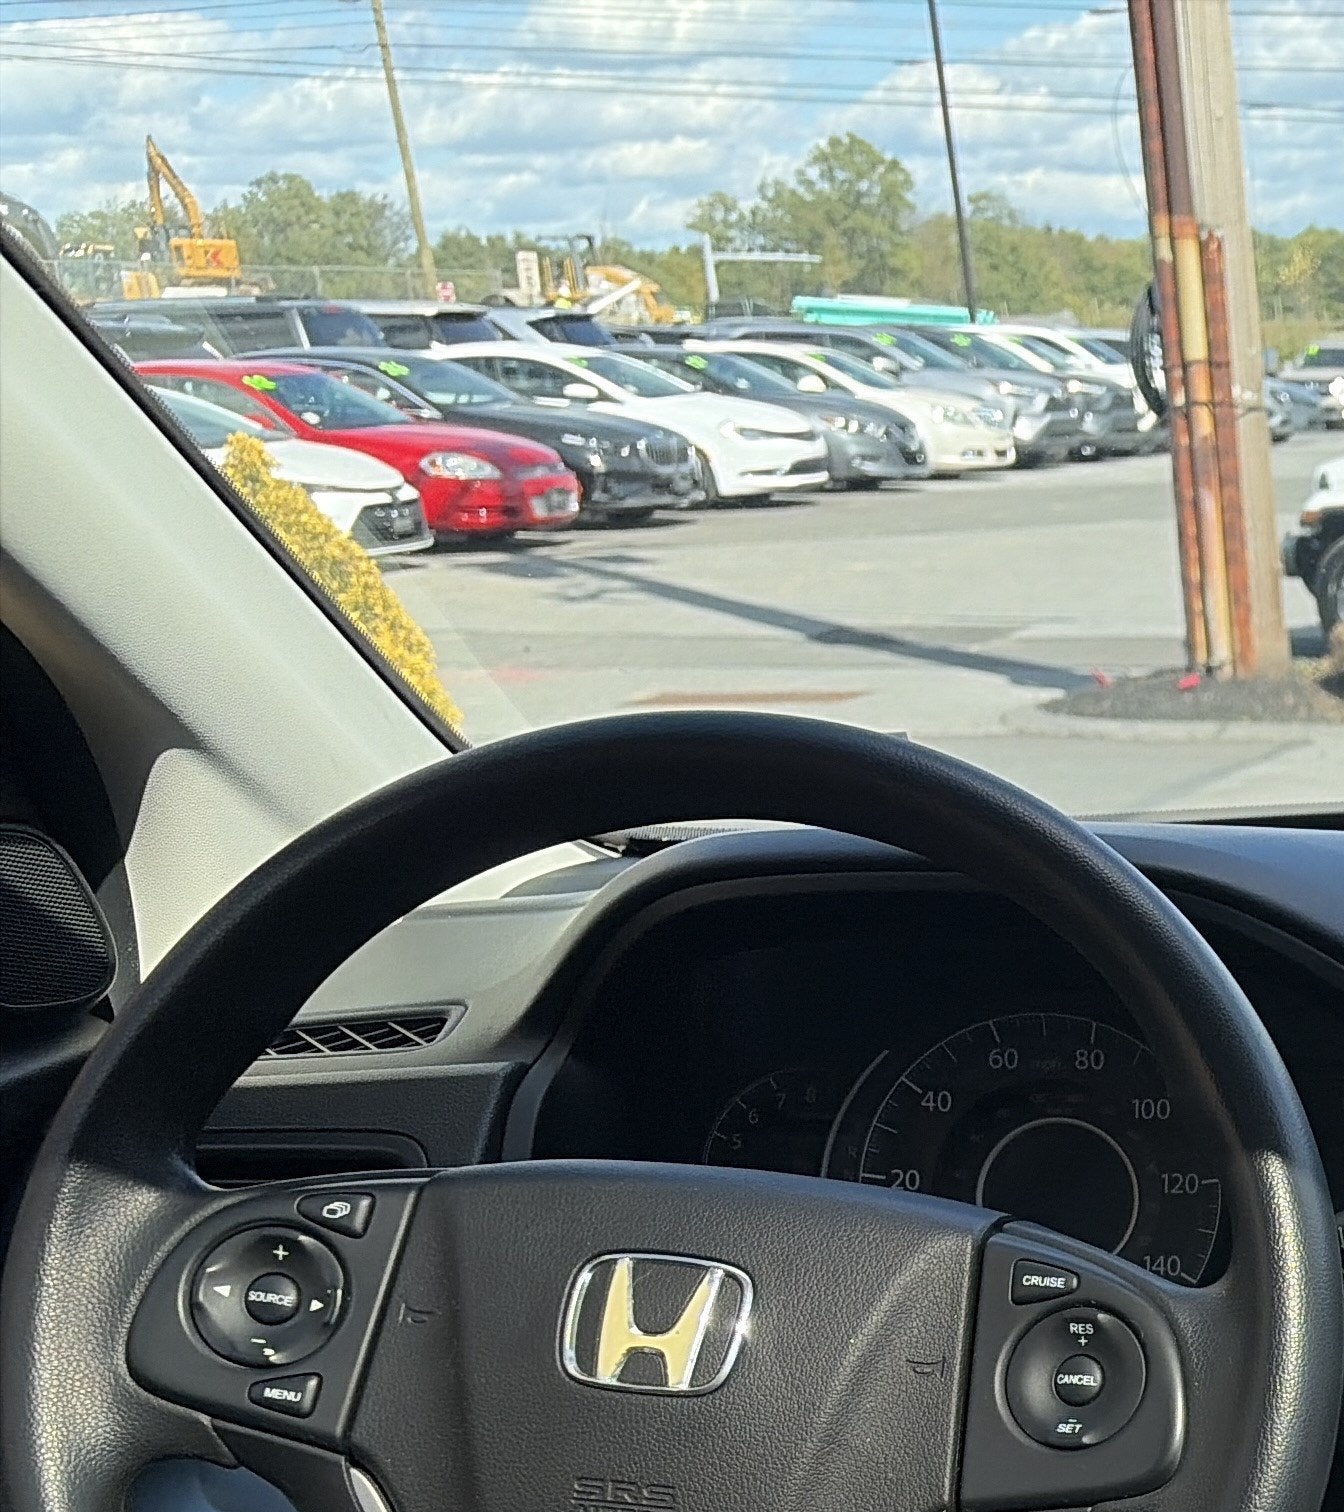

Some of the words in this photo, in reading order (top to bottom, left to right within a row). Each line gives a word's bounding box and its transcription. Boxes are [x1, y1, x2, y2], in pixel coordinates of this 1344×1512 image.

[989, 1048, 1018, 1070] 60
[1074, 1049, 1104, 1071] 80
[921, 1090, 953, 1112] 40
[1131, 1098, 1171, 1121] 100
[890, 1169, 921, 1191] 20
[1161, 1172, 1199, 1195] 120
[1143, 1254, 1182, 1276] 140
[1022, 1275, 1066, 1289] CRUISE
[247, 1290, 294, 1308] SOURCE
[1069, 1322, 1094, 1335] RES
[1056, 1374, 1099, 1387] CANCEL
[263, 1387, 302, 1402] MENU
[1056, 1422, 1083, 1434] SET
[573, 1476, 677, 1503] SRS
